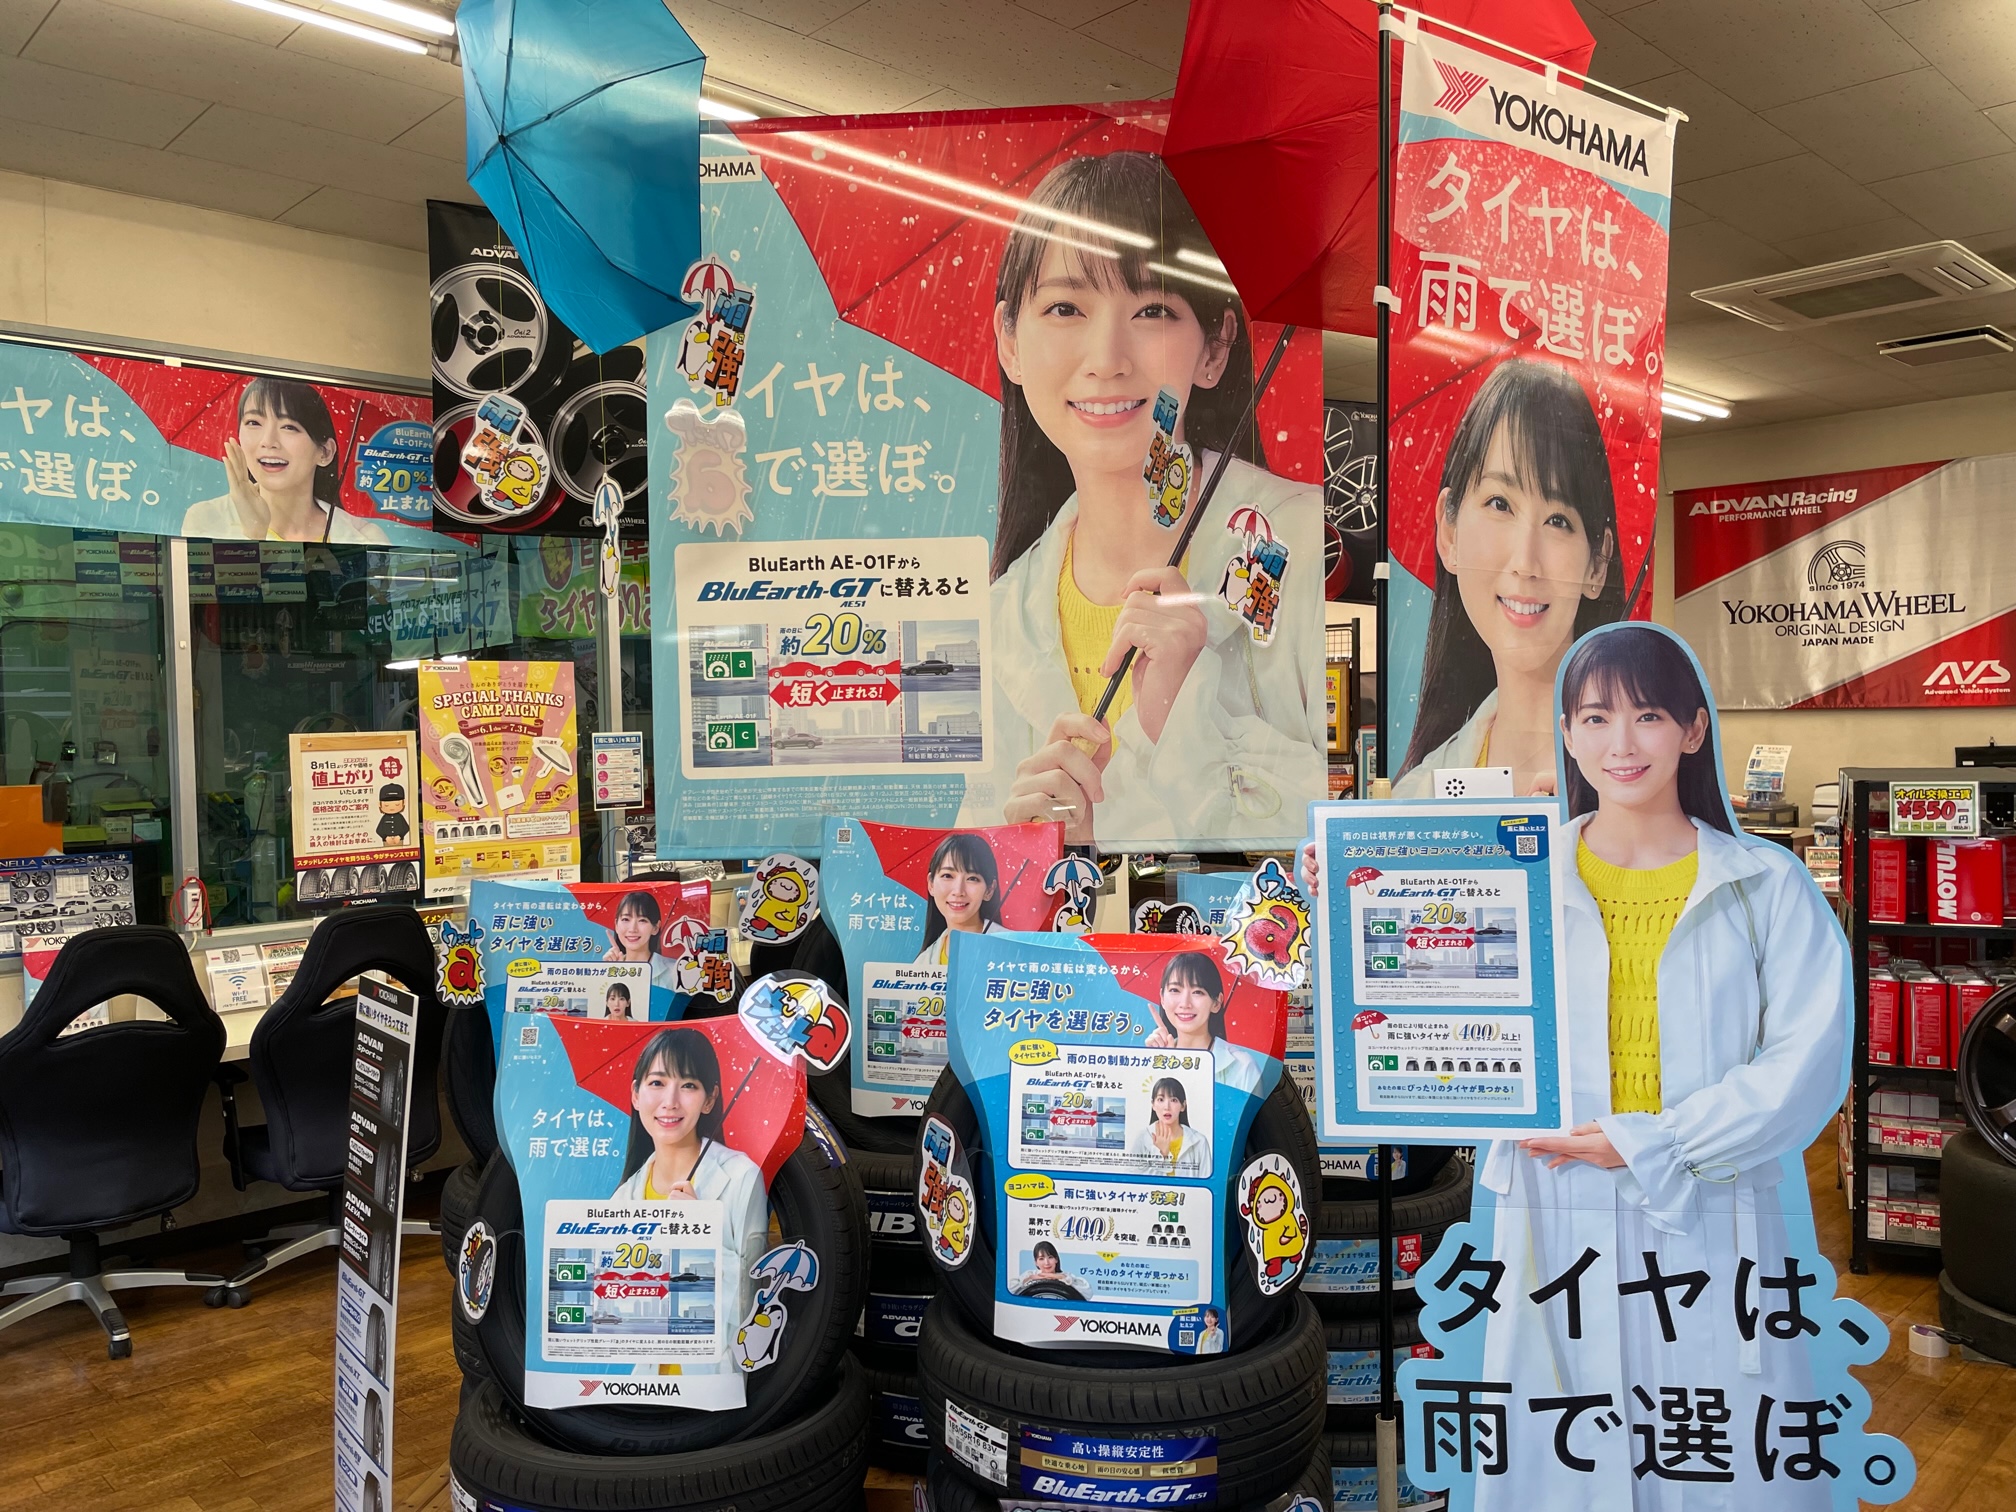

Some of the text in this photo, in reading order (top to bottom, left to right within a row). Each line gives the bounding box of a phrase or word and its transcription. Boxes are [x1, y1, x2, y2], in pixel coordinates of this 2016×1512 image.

[1489, 85, 1650, 177] YOKOHAMA
[1426, 152, 1643, 281] タイヤは、
[1418, 251, 1659, 375] 雨で選ぼ。
[690, 361, 931, 418] イヤは、
[0, 386, 136, 443] ヤは、
[395, 428, 432, 439] BluEarth
[755, 440, 956, 497] で選ぼ。
[380, 495, 433, 512] 止まれ
[1718, 505, 1822, 523] PERFORMANCE WHEEL
[748, 554, 921, 573] BluEarth AE-01Fから
[697, 577, 969, 602] BluEarth-GT に替えると
[1808, 580, 1866, 592] since 1974
[840, 600, 866, 608] AE51
[1721, 590, 1966, 625] YOKOHAMA WHEEL
[1774, 619, 1905, 637] ORIGINAL DESIGN
[1801, 635, 1874, 647] JAPAN MADE
[738, 659, 747, 669] a
[433, 689, 565, 709] SPECIAL THANKS
[788, 681, 884, 706] 短く止まれる!
[1924, 686, 2011, 696] Advanced Vehicle System
[461, 704, 541, 719] CAMPAIGN
[311, 770, 374, 787] 値上がり
[1896, 800, 1957, 821] ¥550
[1400, 878, 1435, 886] BluEarth
[1936, 842, 1958, 921] MOTUL
[350, 898, 378, 906] YOKOHAMA
[849, 891, 916, 910] タイヤは、
[1376, 887, 1501, 899] BluEarth-GT に替えると
[491, 915, 554, 931] 雨に強い
[848, 914, 921, 932] 雨で選ぼ。
[490, 936, 603, 953] タイヤを選ぼう。
[895, 970, 930, 979] BluEarth
[986, 961, 1149, 977] タイヤで雨の運転は変わるから、
[984, 978, 1073, 1001] 雨に強い
[983, 1007, 1146, 1036] タイヤを選ぼう。
[357, 1031, 384, 1053] ADVAN
[356, 1044, 376, 1060] Sport
[1045, 1070, 1072, 1078] BluEarth
[1026, 1078, 1092, 1089] BluEarth-GT
[351, 1110, 378, 1135] ADVAN
[532, 1108, 614, 1129] タイヤは、
[528, 1136, 621, 1158] 雨で選ぼ。
[345, 1190, 372, 1218] ADVAN
[587, 1209, 685, 1219] BluEarth AE-01Fから
[556, 1222, 712, 1235] BluEarth-GT に替えると
[1434, 1242, 1870, 1346] タイヤは、
[1080, 1319, 1162, 1337] YOKOHAMA
[602, 1383, 681, 1396] YOKOHAMA
[949, 1404, 990, 1432] BluEarth-GT
[1415, 1378, 1896, 1486] 雨で選ぼ。
[1072, 1441, 1165, 1460] 高い操縦安定性
[1032, 1475, 1192, 1504] BluEarth-GT
